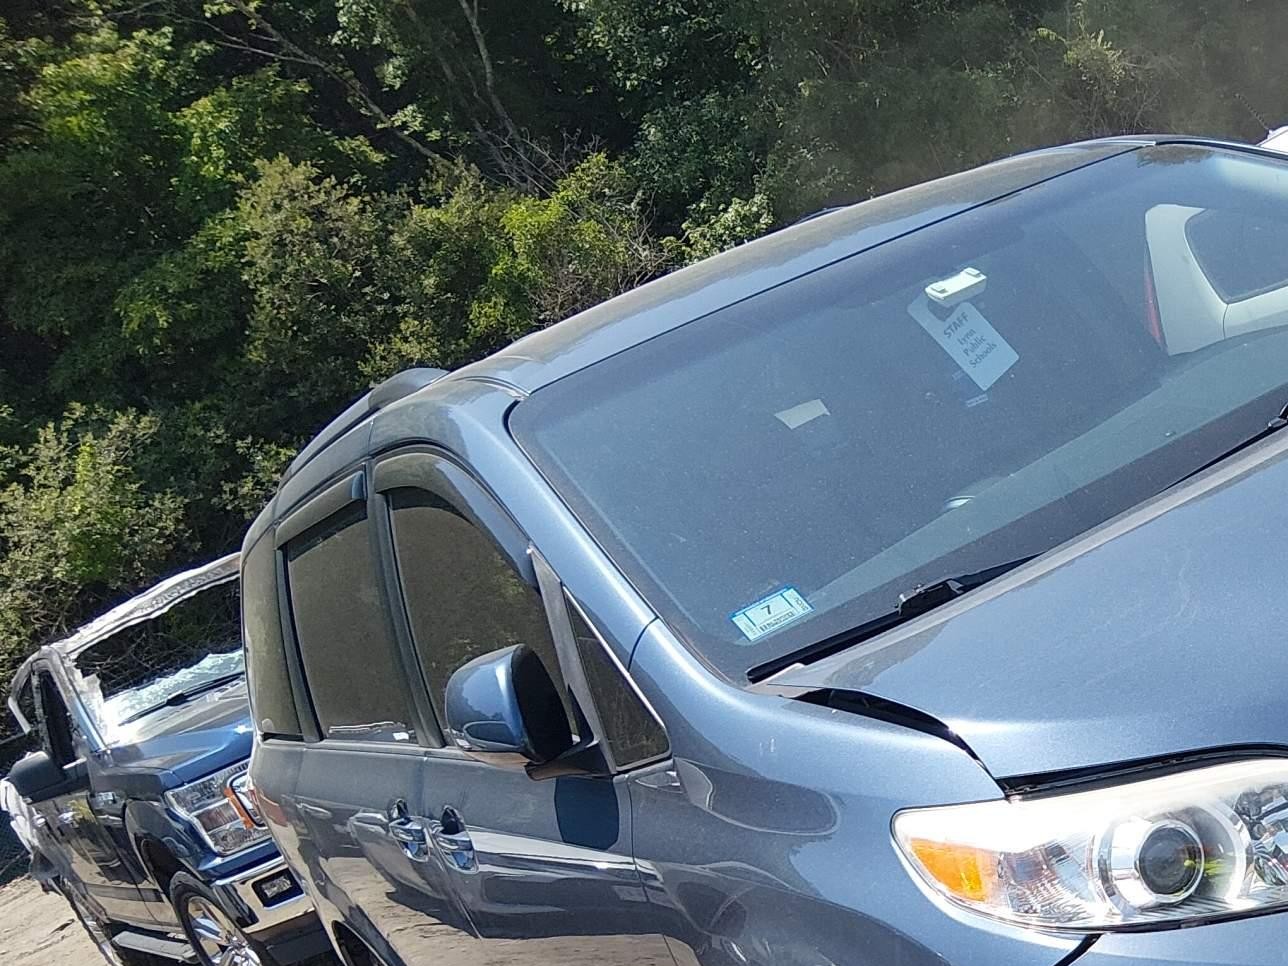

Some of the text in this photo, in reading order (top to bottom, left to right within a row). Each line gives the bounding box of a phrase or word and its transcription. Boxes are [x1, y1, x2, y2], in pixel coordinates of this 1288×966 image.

[943, 311, 968, 338] STAFF
[957, 328, 976, 345] Lynn
[963, 335, 985, 356] Public
[969, 342, 997, 368] Schools
[761, 604, 771, 615] 7
